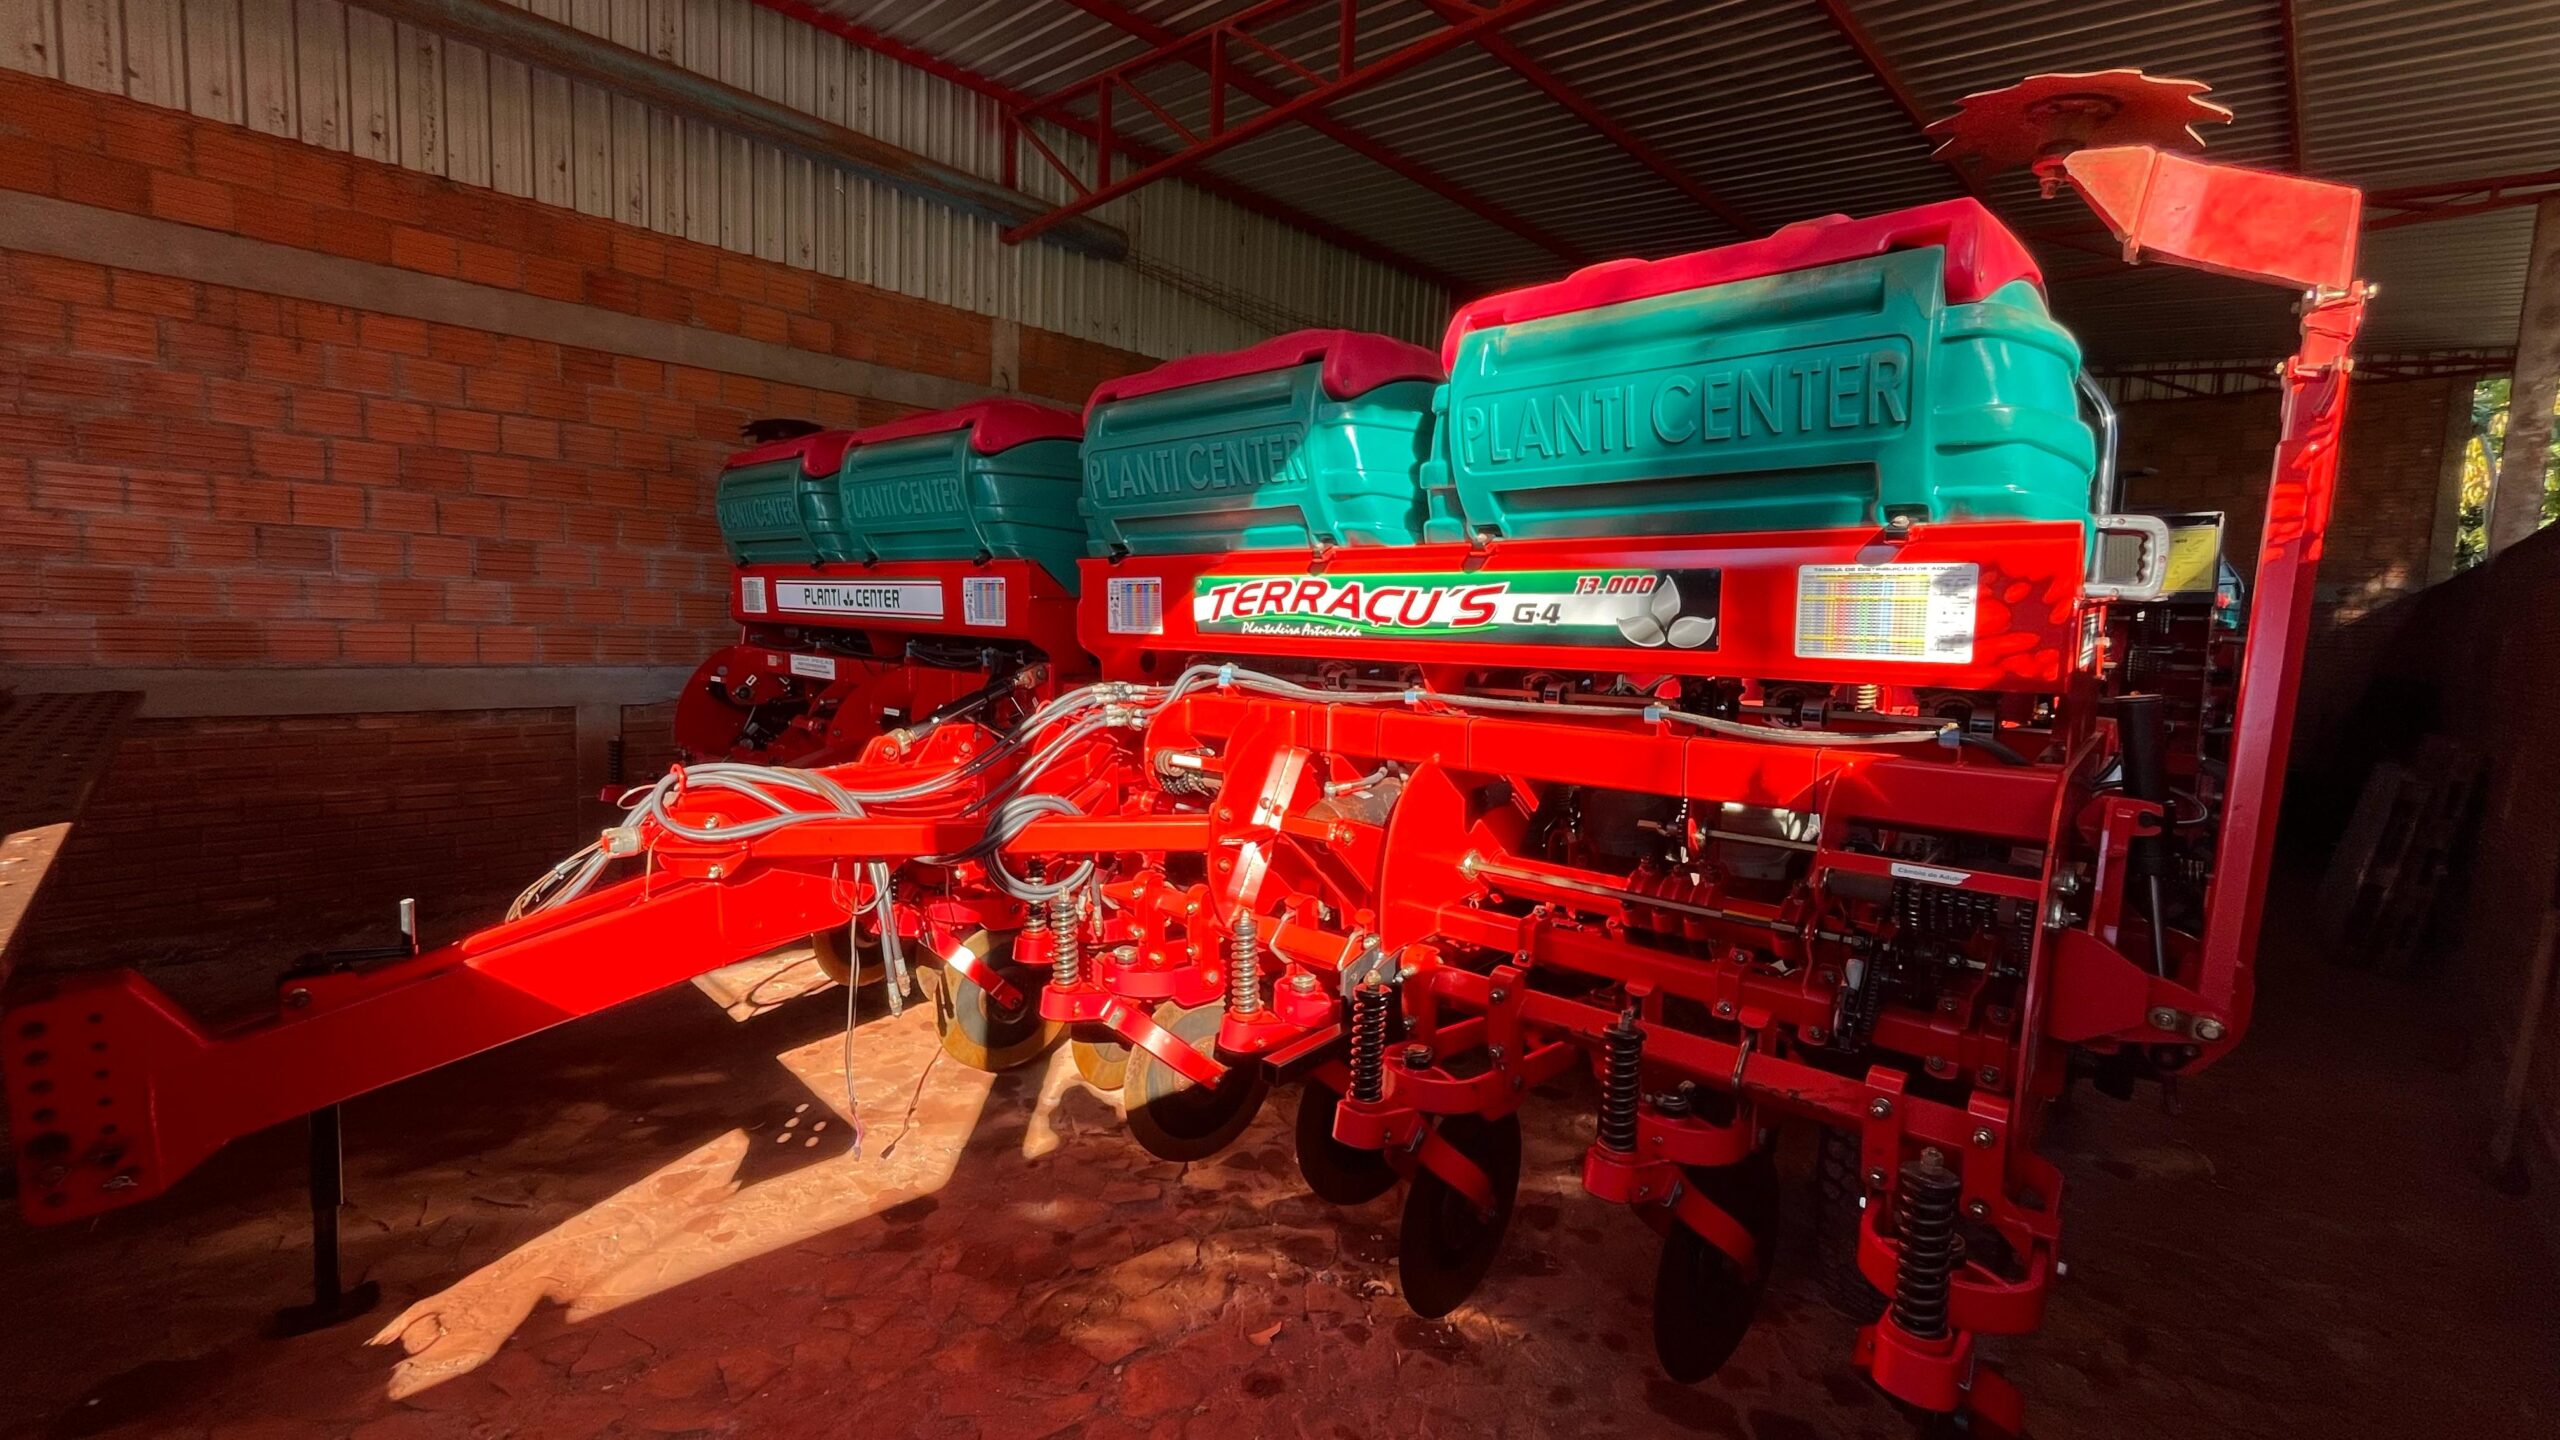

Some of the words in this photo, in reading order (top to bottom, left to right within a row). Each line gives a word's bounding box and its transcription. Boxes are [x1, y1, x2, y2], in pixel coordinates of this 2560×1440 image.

[1463, 385, 1636, 465] PLANTI
[1652, 350, 1908, 445] CENTER
[1089, 448, 1181, 500] PLANTI
[1185, 432, 1308, 491] CENTER
[719, 500, 750, 530] PLANTI
[751, 496, 800, 528] CENTER
[844, 484, 897, 519] PLANTI
[901, 477, 965, 515] CENTER
[804, 587, 842, 606] PLANTI
[856, 588, 901, 609] CENTER
[1576, 576, 1656, 595] 13.000
[1242, 621, 1301, 636] Plantadeira
[1302, 622, 1362, 637] Articulada
